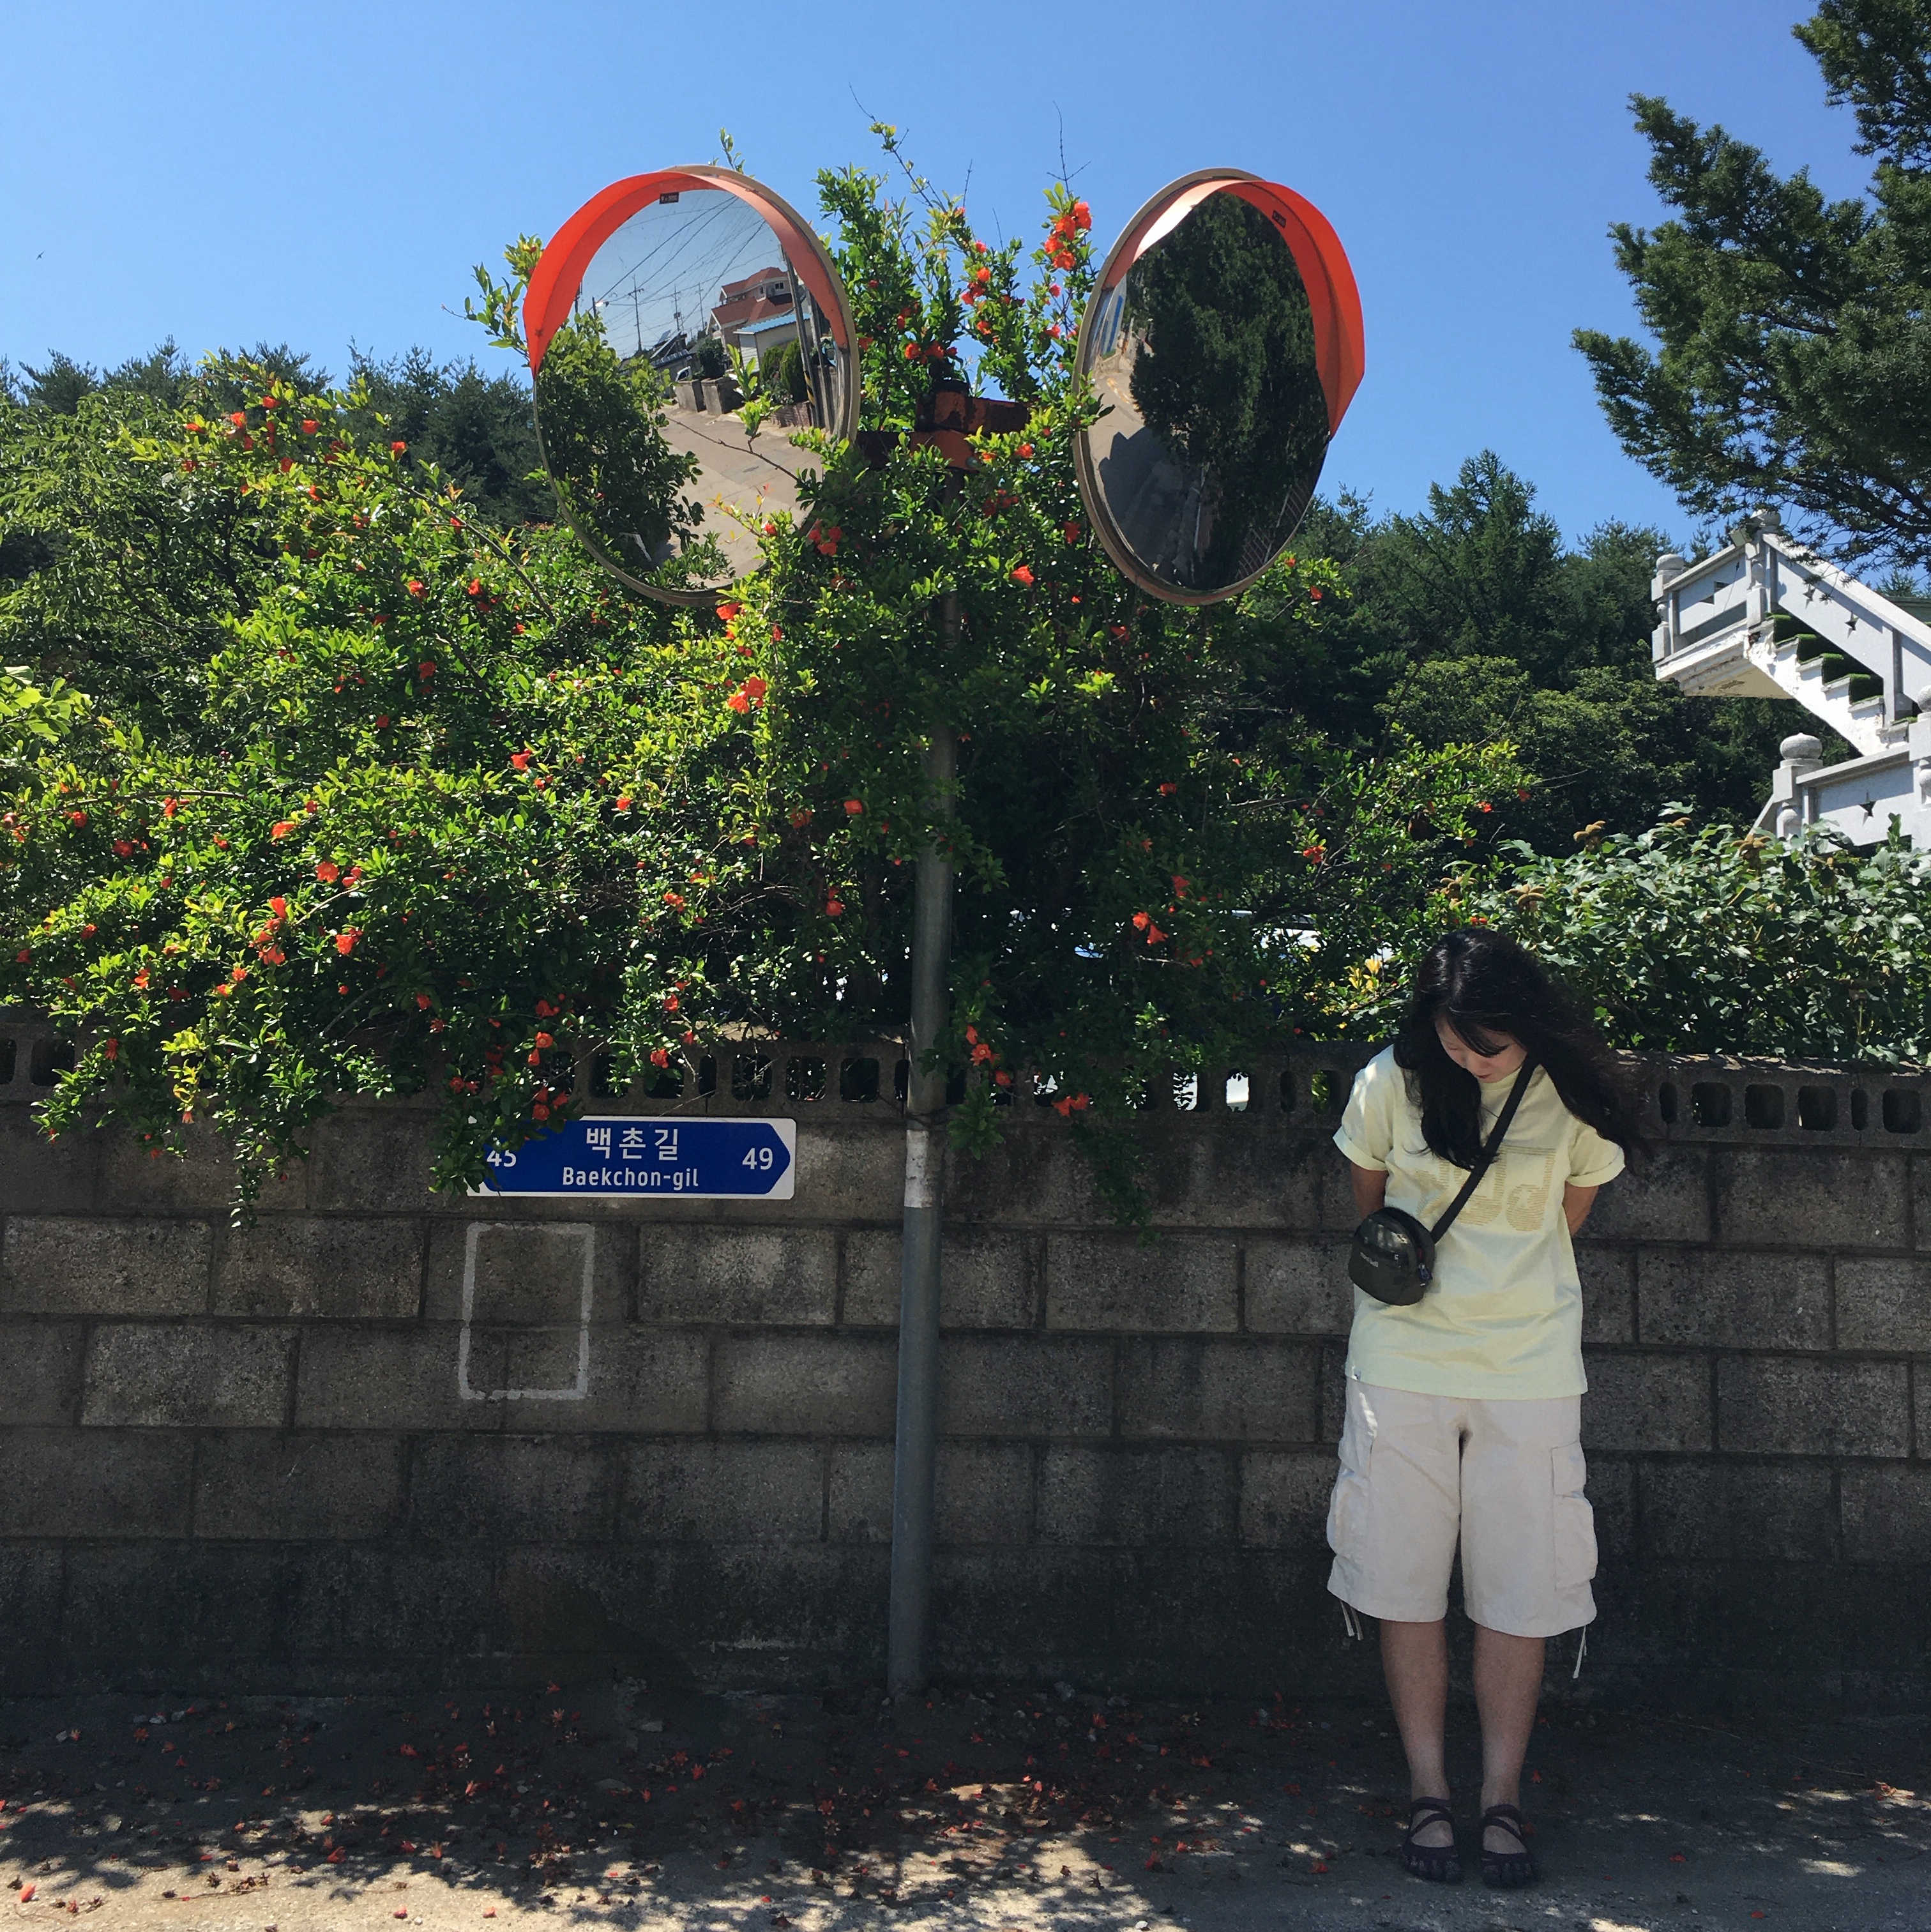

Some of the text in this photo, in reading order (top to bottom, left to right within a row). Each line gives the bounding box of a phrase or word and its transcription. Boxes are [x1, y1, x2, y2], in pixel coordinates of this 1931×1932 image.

[586, 1127, 678, 1160] 백촌길
[487, 1149, 517, 1168] 45
[742, 1147, 773, 1170] 49
[563, 1166, 699, 1190] Baekchon-gil
